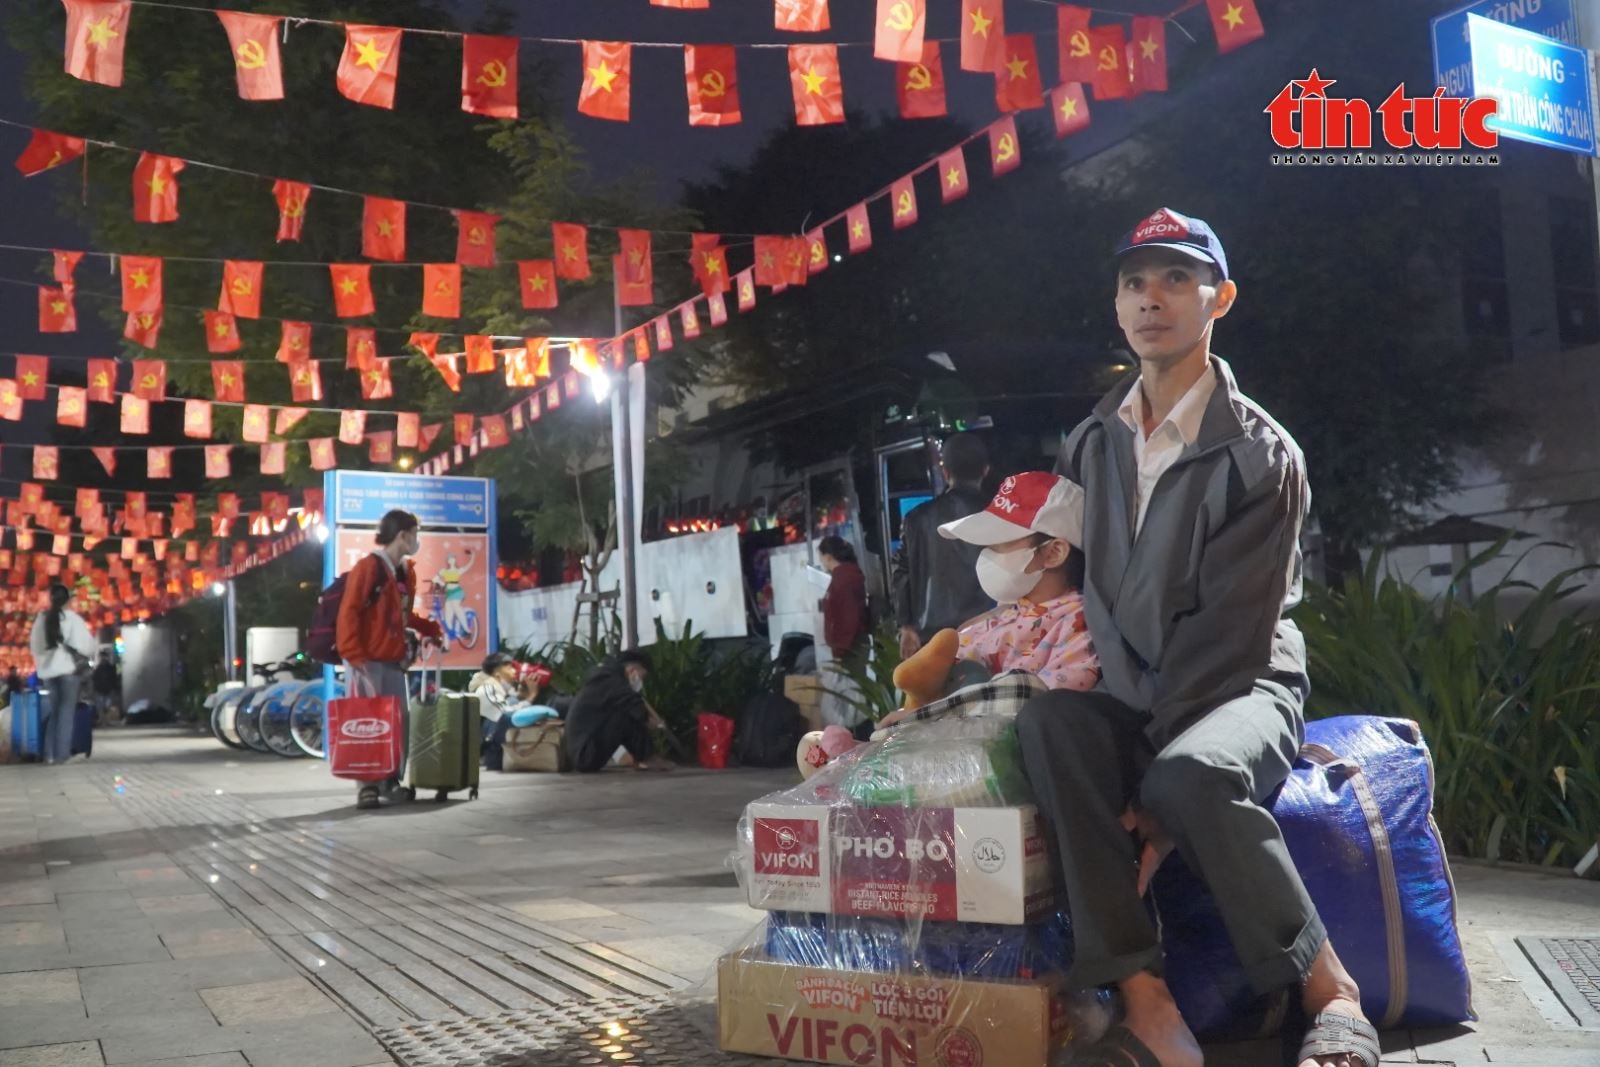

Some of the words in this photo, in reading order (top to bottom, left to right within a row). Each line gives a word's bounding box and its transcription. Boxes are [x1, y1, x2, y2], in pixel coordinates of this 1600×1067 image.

[1539, 92, 1564, 135] CÔNG
[1564, 100, 1591, 142] CHÚA
[1135, 224, 1179, 238] VIFON
[836, 831, 895, 859] PHỞ
[906, 834, 948, 861] BÒ
[761, 852, 814, 869] VIFON
[882, 891, 899, 901] RICE
[803, 989, 857, 1009] VIFON
[873, 998, 911, 1019] TIỆN
[915, 1003, 942, 1022] LỢI
[767, 1013, 918, 1067] VIFON
